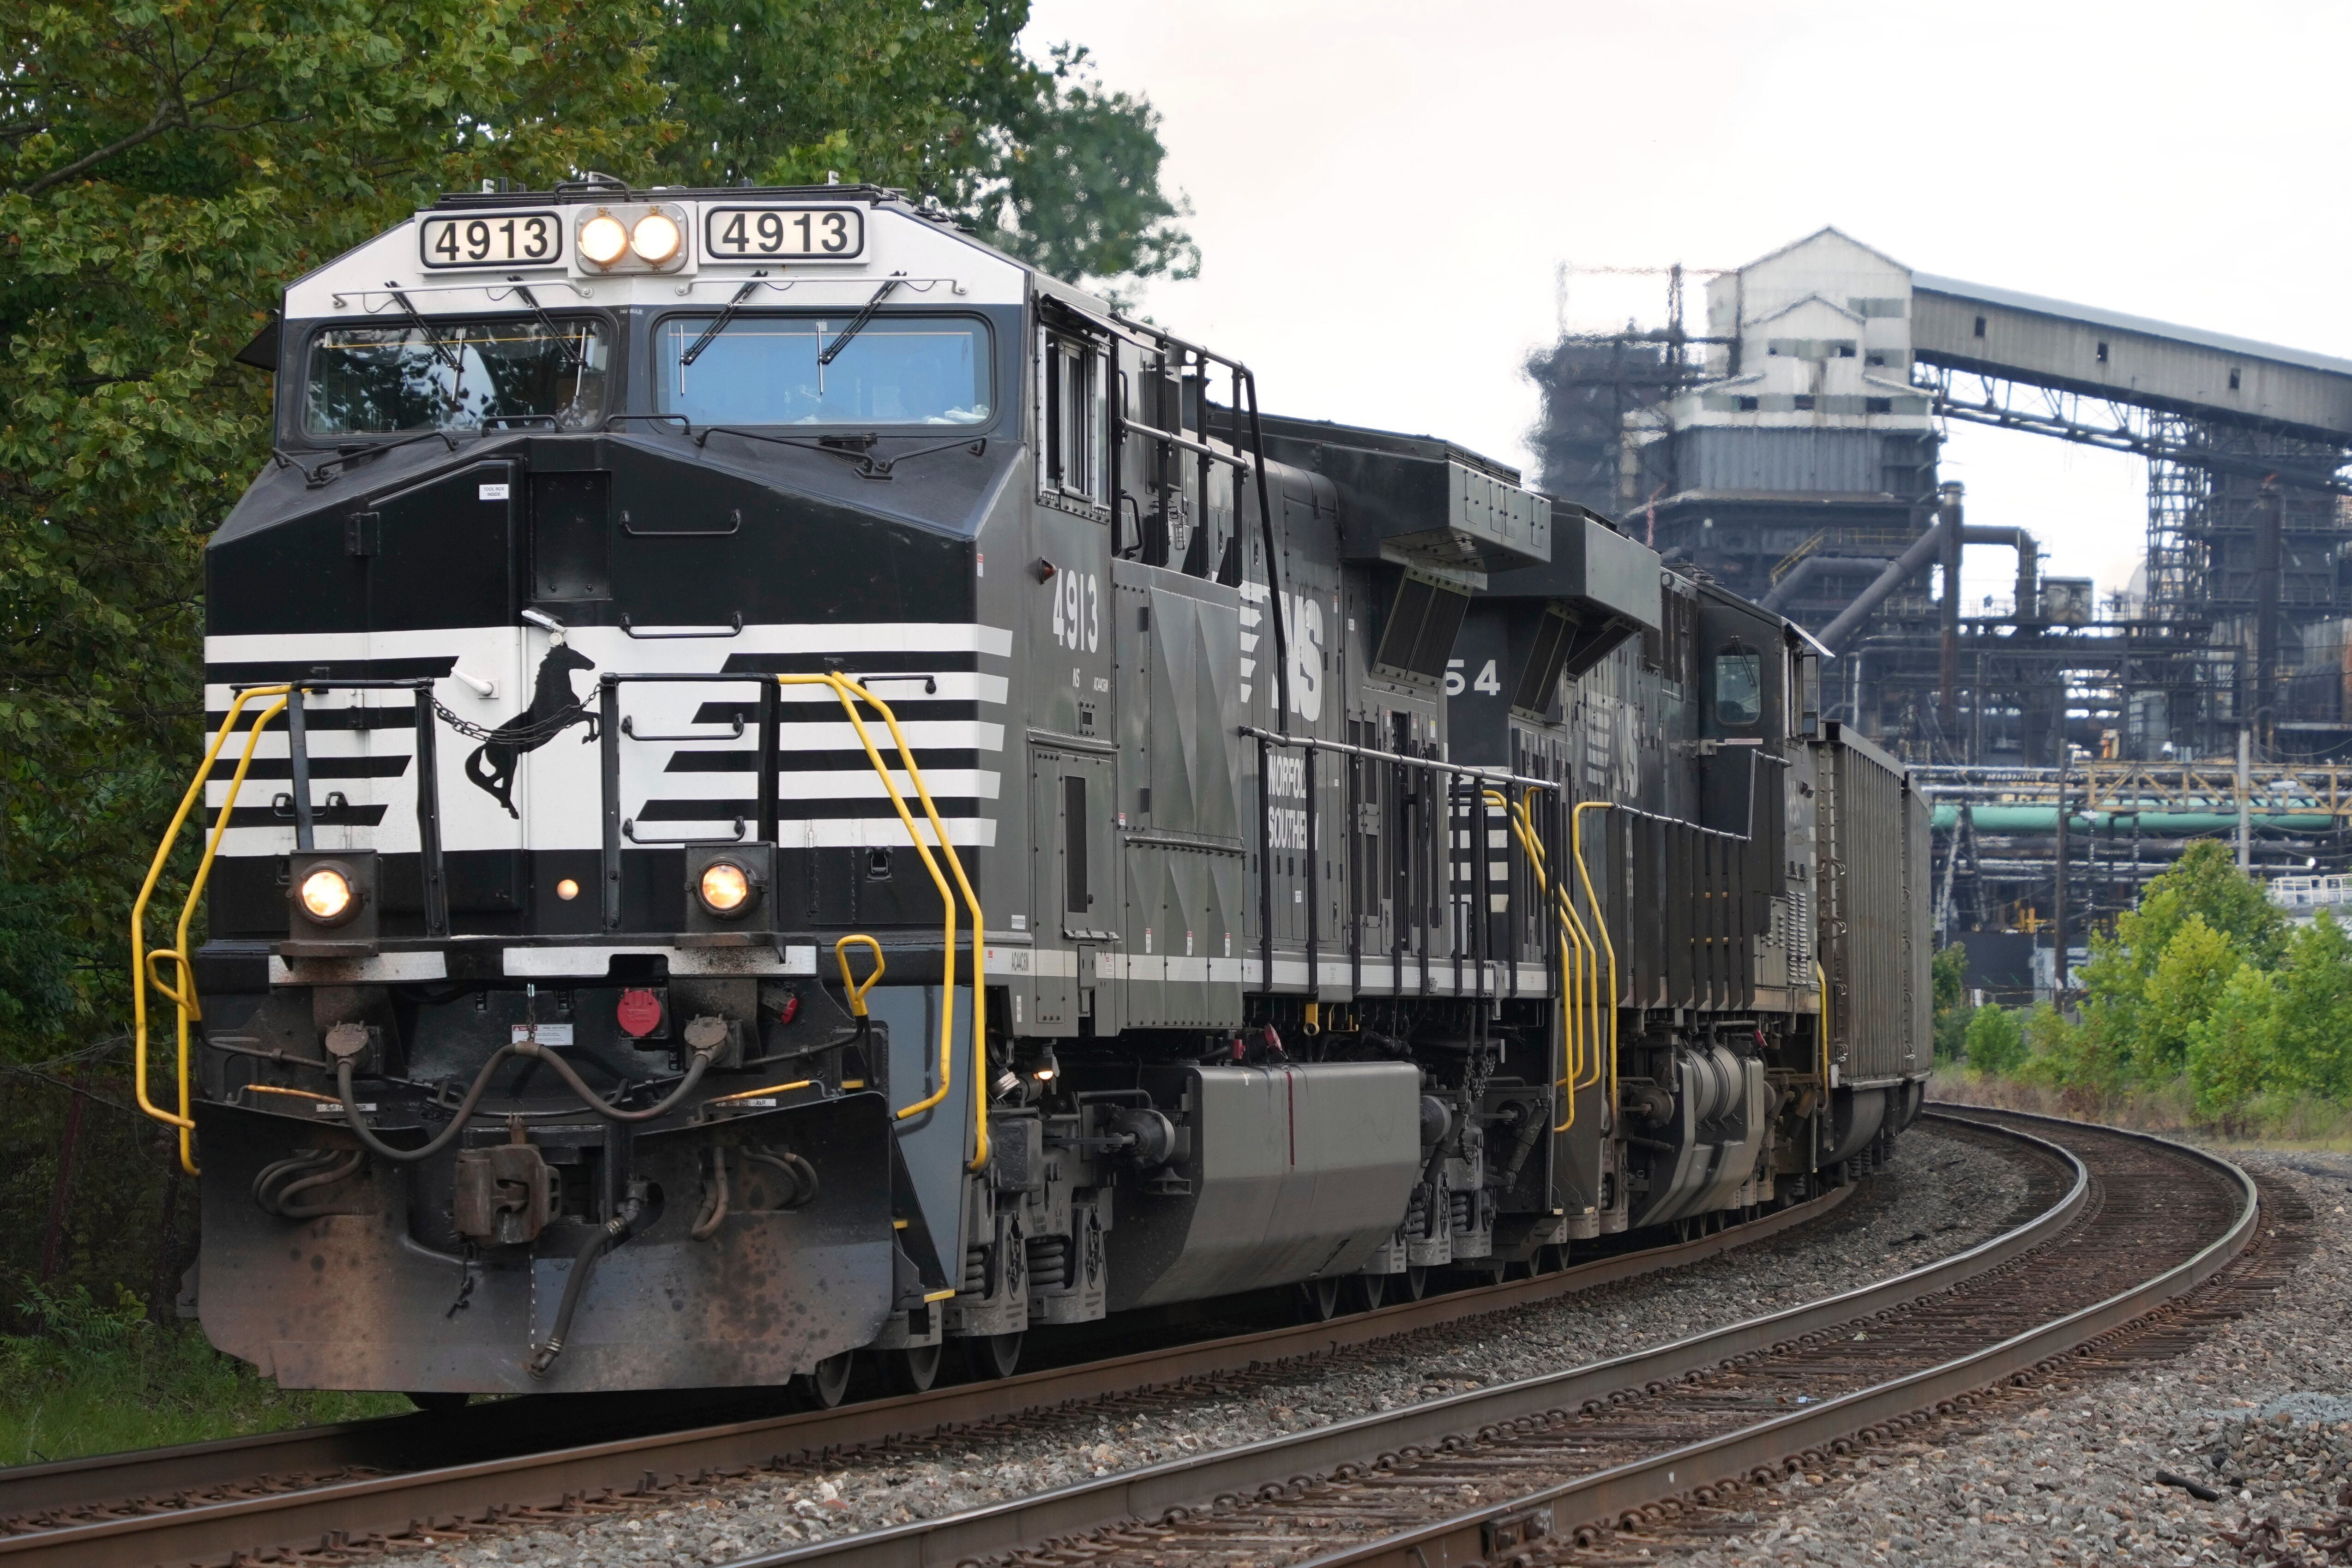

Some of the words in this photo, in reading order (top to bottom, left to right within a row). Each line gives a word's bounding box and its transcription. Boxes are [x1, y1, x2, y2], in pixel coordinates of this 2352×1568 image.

[435, 217, 548, 261] 4913
[722, 212, 848, 252] 4913
[1053, 568, 1098, 653] 4913
[1072, 667, 1080, 688] NS
[1272, 590, 1323, 721] NS
[1268, 755, 1307, 799] NORFOL
